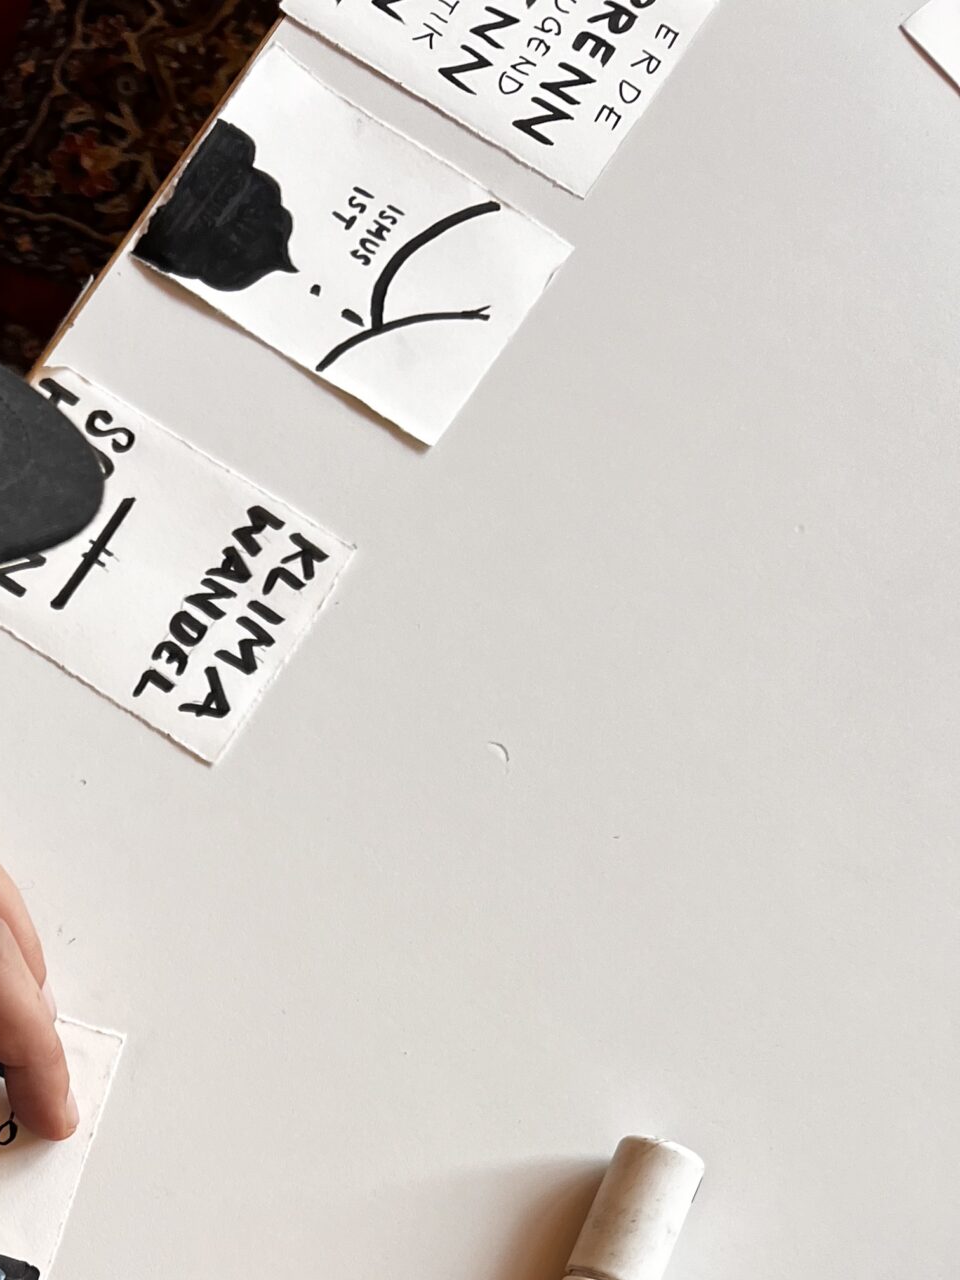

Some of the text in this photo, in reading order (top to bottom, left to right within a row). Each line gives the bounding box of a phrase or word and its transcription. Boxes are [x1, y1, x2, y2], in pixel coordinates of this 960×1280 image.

[594, 24, 679, 130] ERDE
[332, 184, 376, 233] IST
[348, 203, 407, 269] ISMUS
[131, 501, 287, 700] WANDEL
[177, 530, 331, 720] KLIMA
